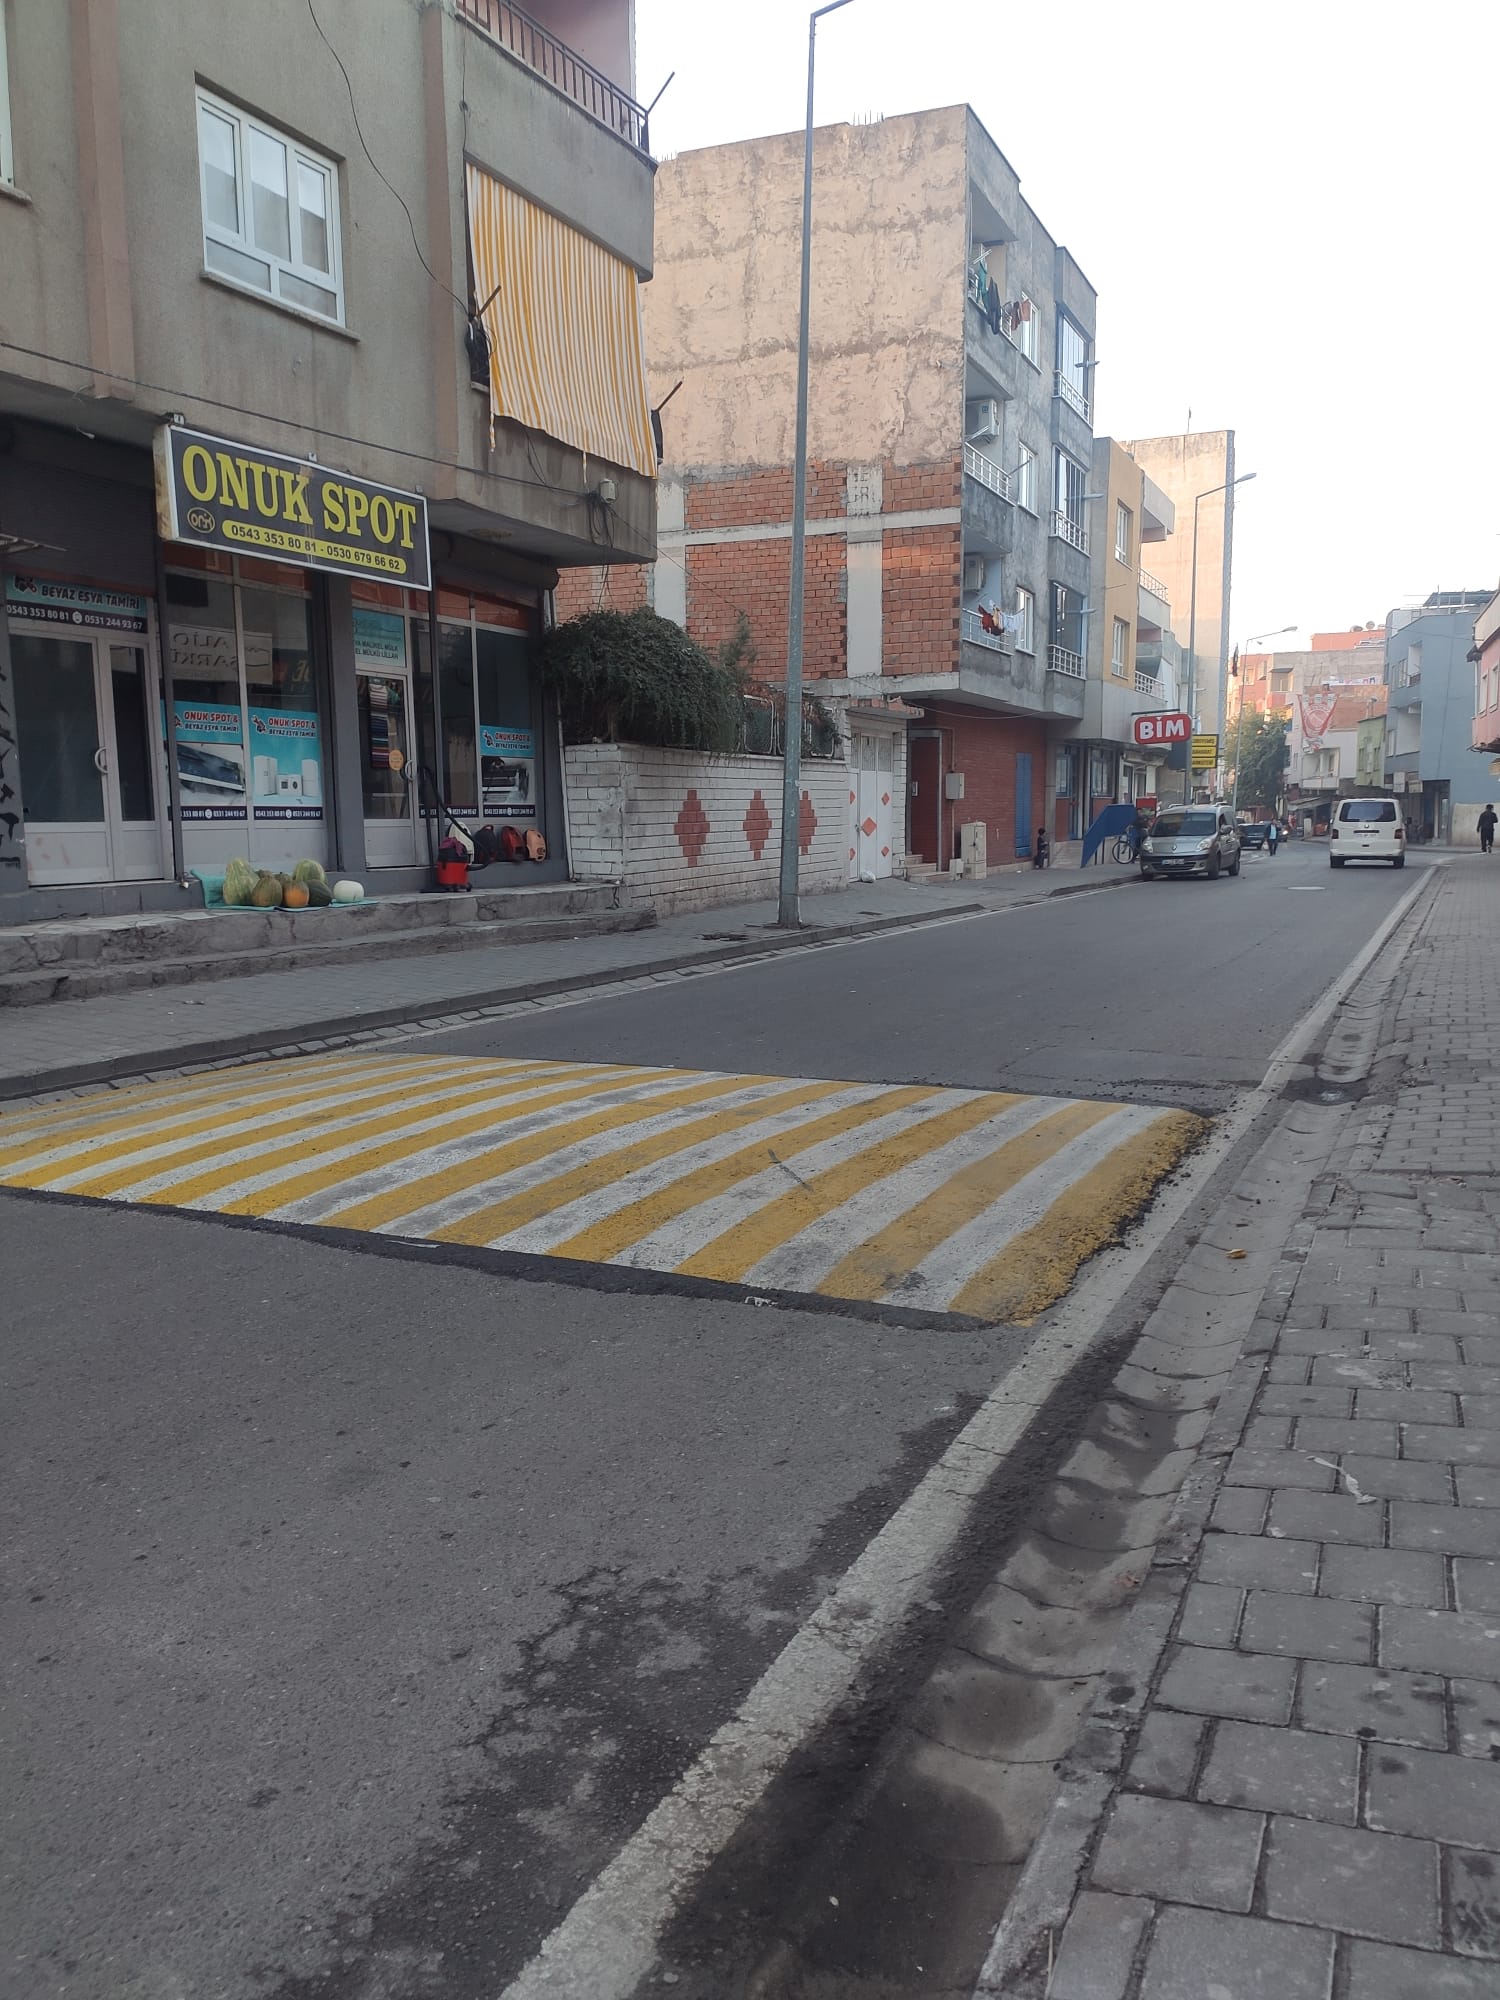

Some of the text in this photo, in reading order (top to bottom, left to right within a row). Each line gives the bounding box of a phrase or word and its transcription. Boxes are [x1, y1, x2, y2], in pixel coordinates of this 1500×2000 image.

[183, 445, 416, 549] ONUK SPOT
[231, 524, 260, 540] 0543
[264, 531, 284, 545] 353
[288, 537, 301, 549] 80
[304, 541, 317, 552] 81
[327, 545, 351, 560] 0530
[354, 552, 372, 564] 679
[375, 556, 386, 567] 66
[388, 559, 400, 570] 62
[41, 585, 139, 609] BEYAZ EŞYA TAMİRİ
[7, 604, 143, 630] 0543 353 80 81 0531 244 93 67
[184, 711, 208, 720] ONUK
[210, 713, 230, 722] SPOT
[269, 718, 289, 726] ONUK
[291, 719, 309, 728] SPOT
[1140, 717, 1185, 739] BİM
